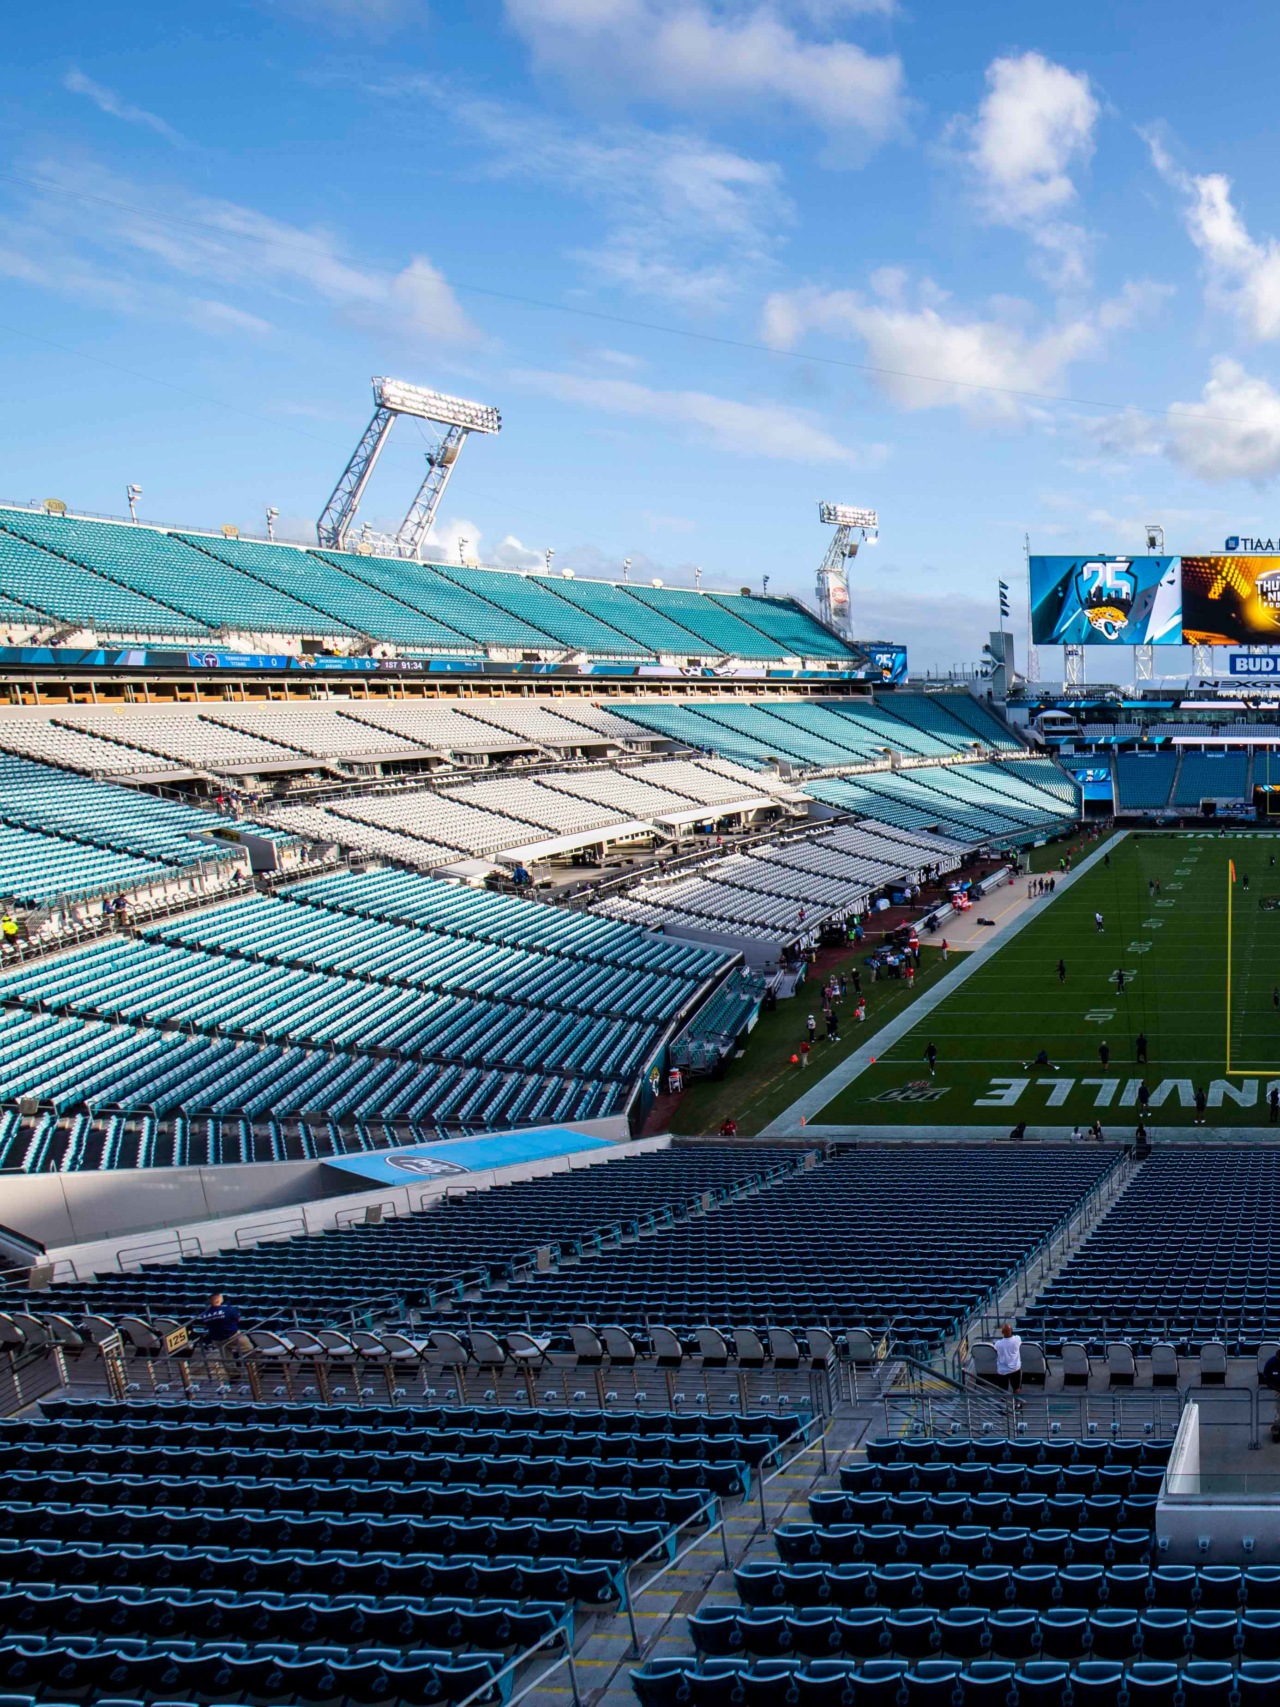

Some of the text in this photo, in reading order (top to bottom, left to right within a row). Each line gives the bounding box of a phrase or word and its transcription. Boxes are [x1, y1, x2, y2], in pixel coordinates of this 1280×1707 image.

[1241, 538, 1275, 551] TIAA
[1083, 562, 1132, 602] 25
[271, 658, 278, 667] 0
[365, 660, 371, 669] 0
[401, 661, 423, 670] 91:34
[1235, 657, 1274, 672] BUD
[1126, 941, 1152, 952] 30
[1084, 1007, 1117, 1021] 10
[168, 1332, 186, 1348] 125
